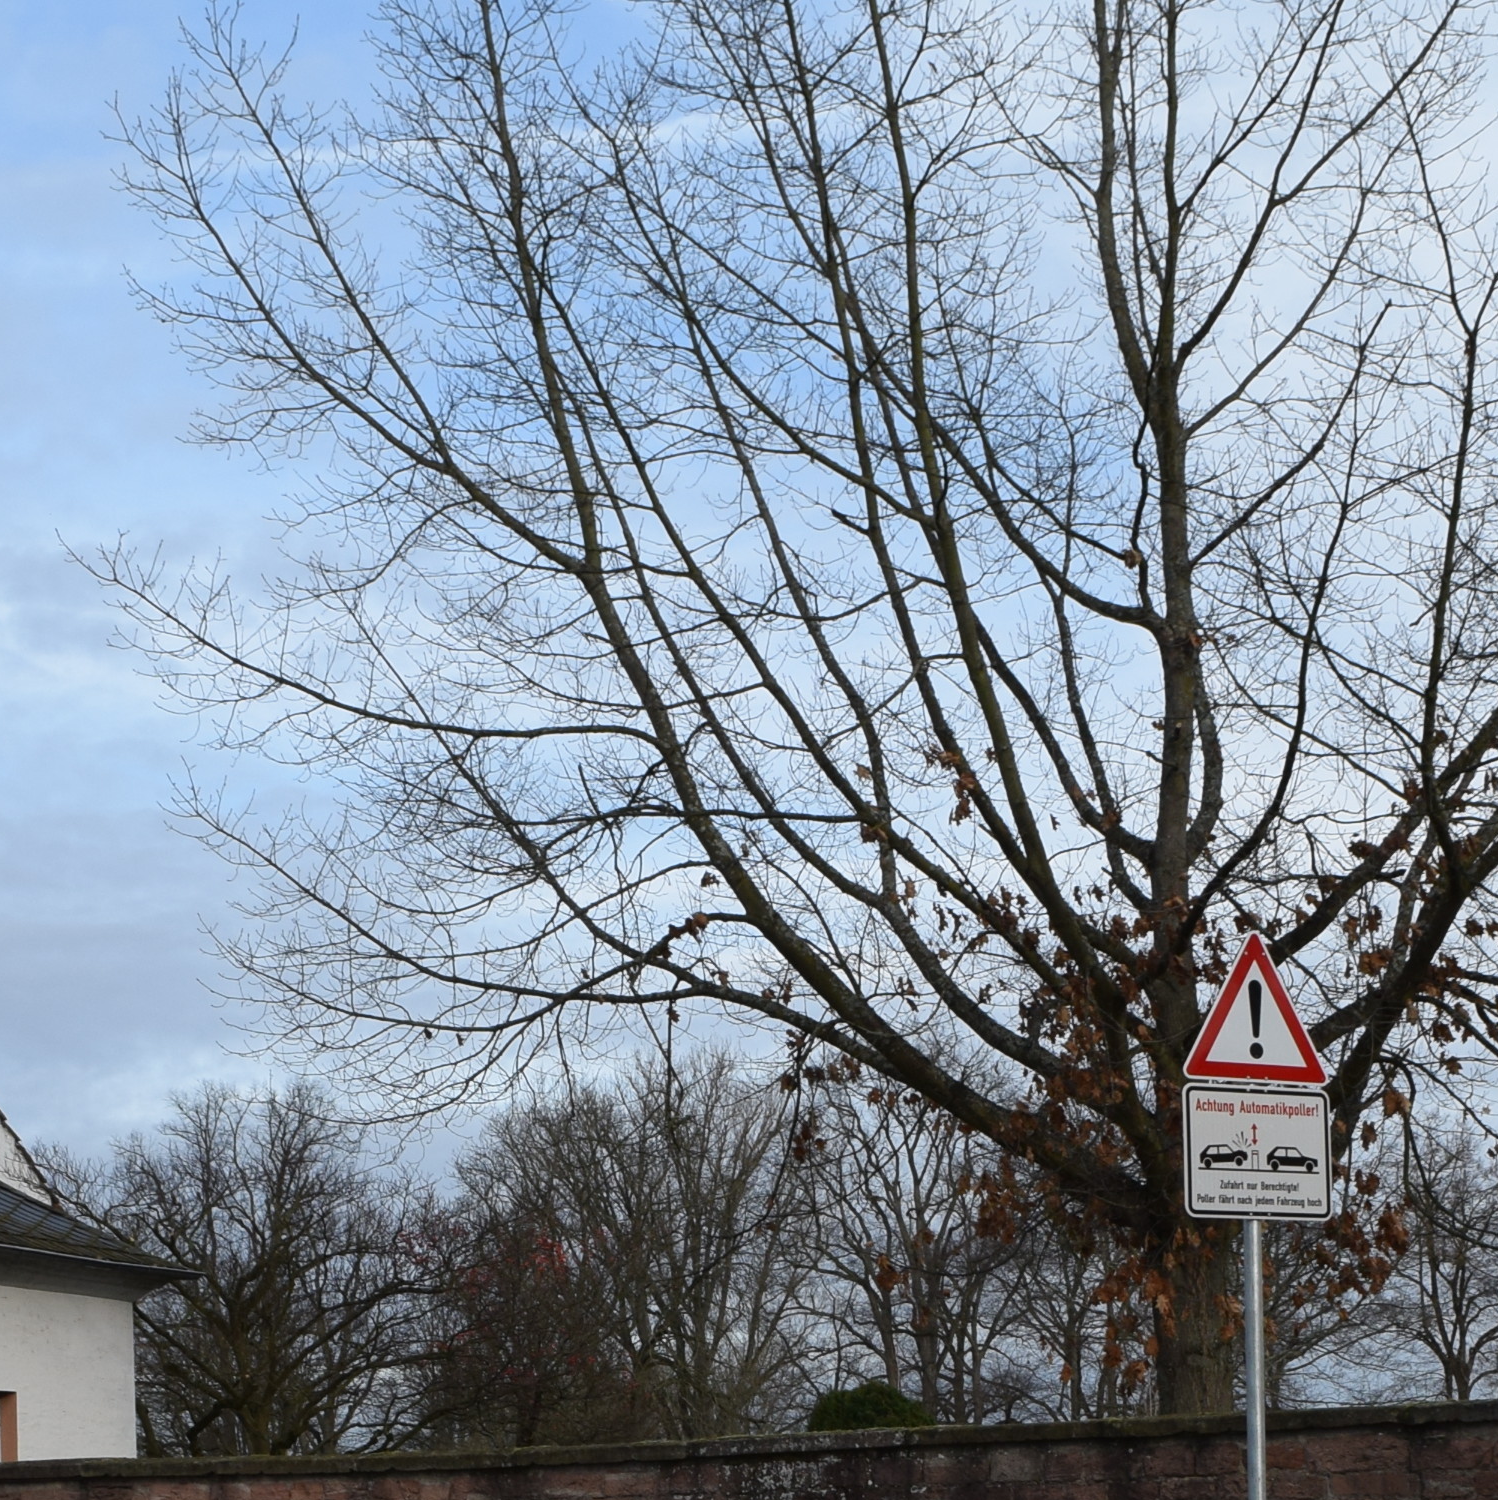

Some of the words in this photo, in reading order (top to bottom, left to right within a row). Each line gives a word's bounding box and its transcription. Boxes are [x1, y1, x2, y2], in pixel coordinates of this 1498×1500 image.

[1195, 1097, 1235, 1116] Achtung
[1239, 1100, 1319, 1119] Automatikpoller!
[1220, 1180, 1244, 1190] Zufahrt
[1247, 1182, 1258, 1190] nur
[1261, 1181, 1300, 1193] Berechtigte!
[1197, 1194, 1216, 1203] Poller
[1218, 1194, 1235, 1204] fährt
[1237, 1195, 1252, 1205] nach
[1255, 1195, 1275, 1207] jedem
[1277, 1196, 1305, 1208] Fahrzeug
[1307, 1197, 1322, 1207] hoch
